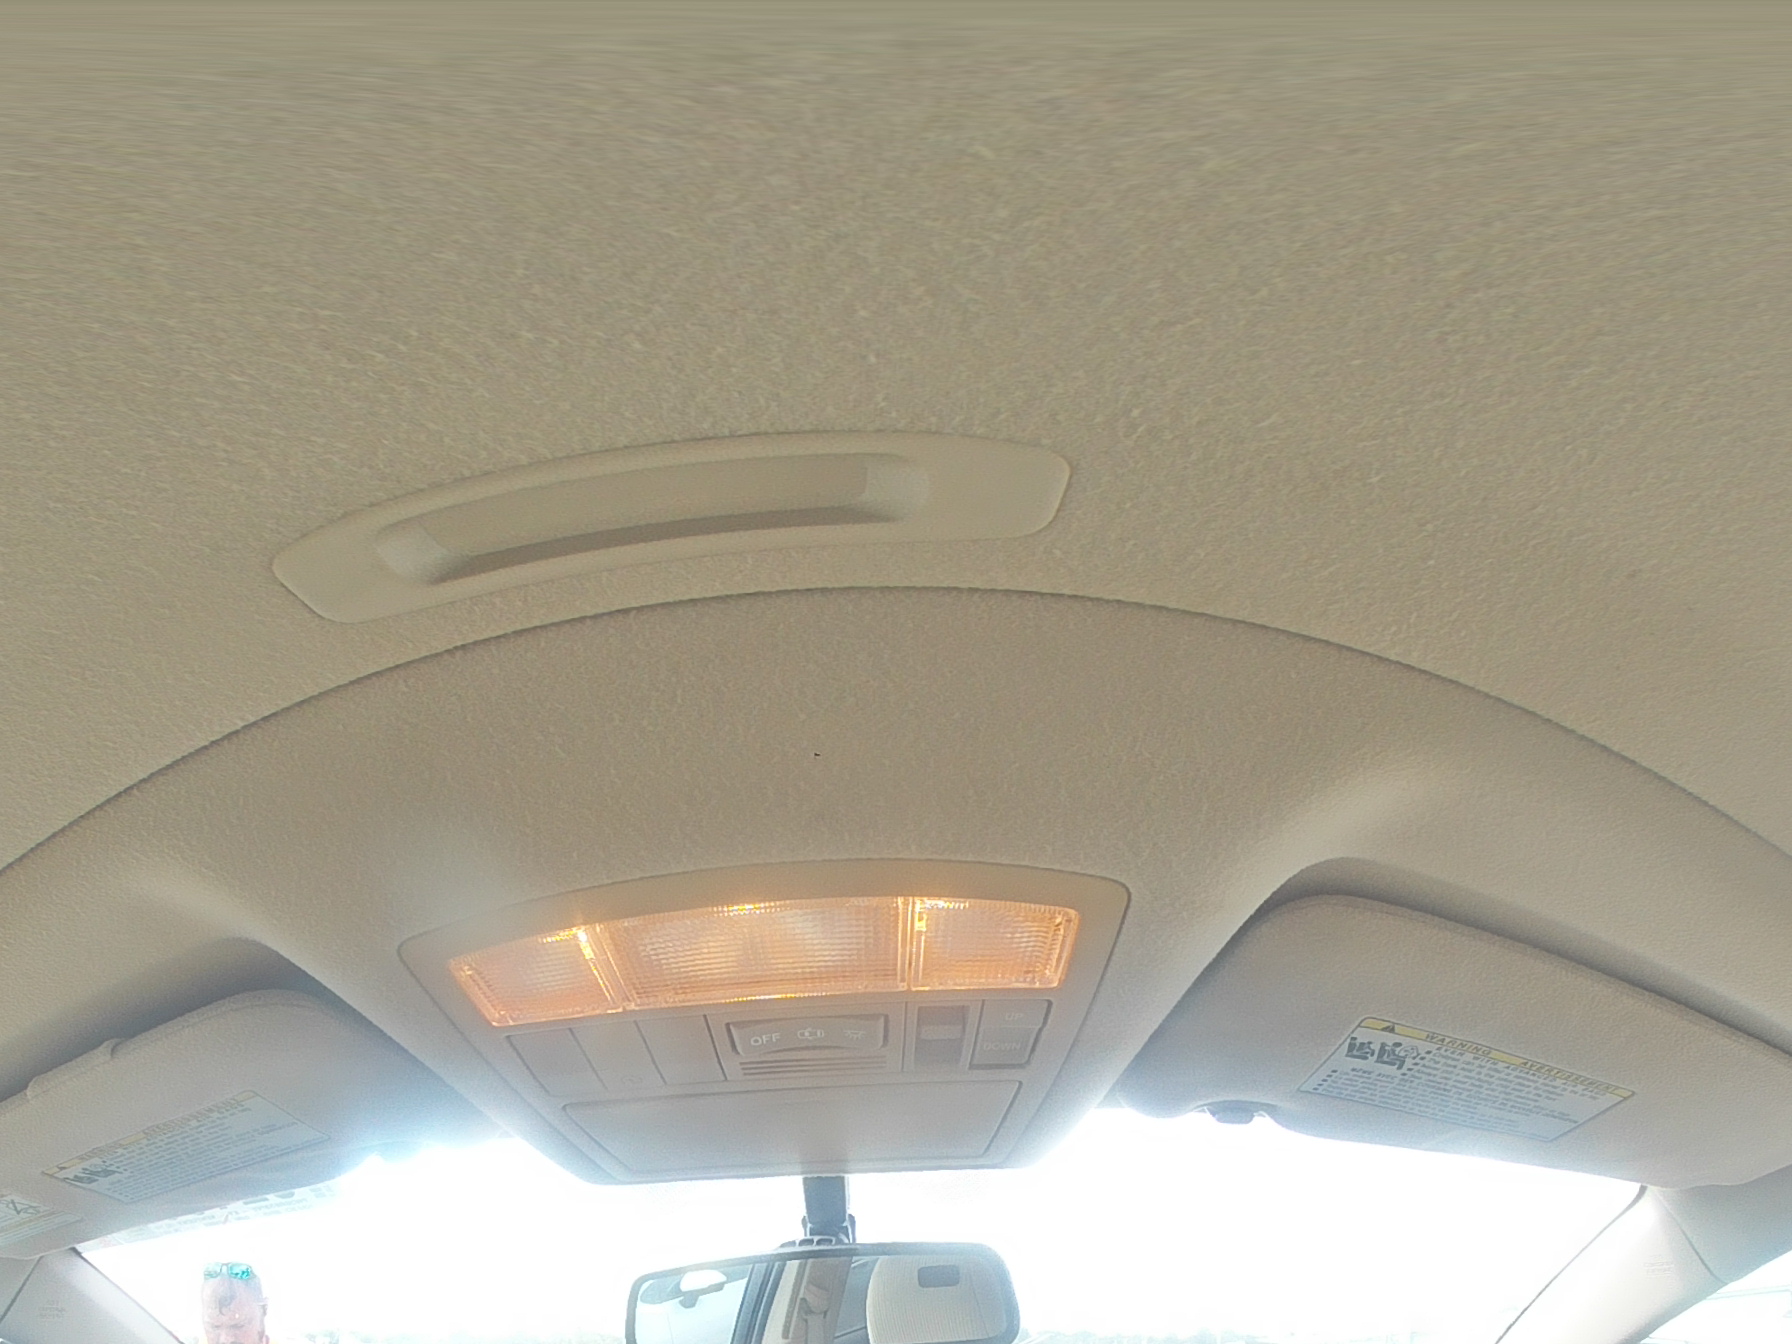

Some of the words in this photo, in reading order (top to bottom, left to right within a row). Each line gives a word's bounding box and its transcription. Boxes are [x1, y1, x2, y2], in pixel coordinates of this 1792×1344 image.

[750, 1031, 781, 1047] OFF
[983, 1041, 1021, 1051] DOWN
[1425, 1033, 1493, 1056] WARNING
